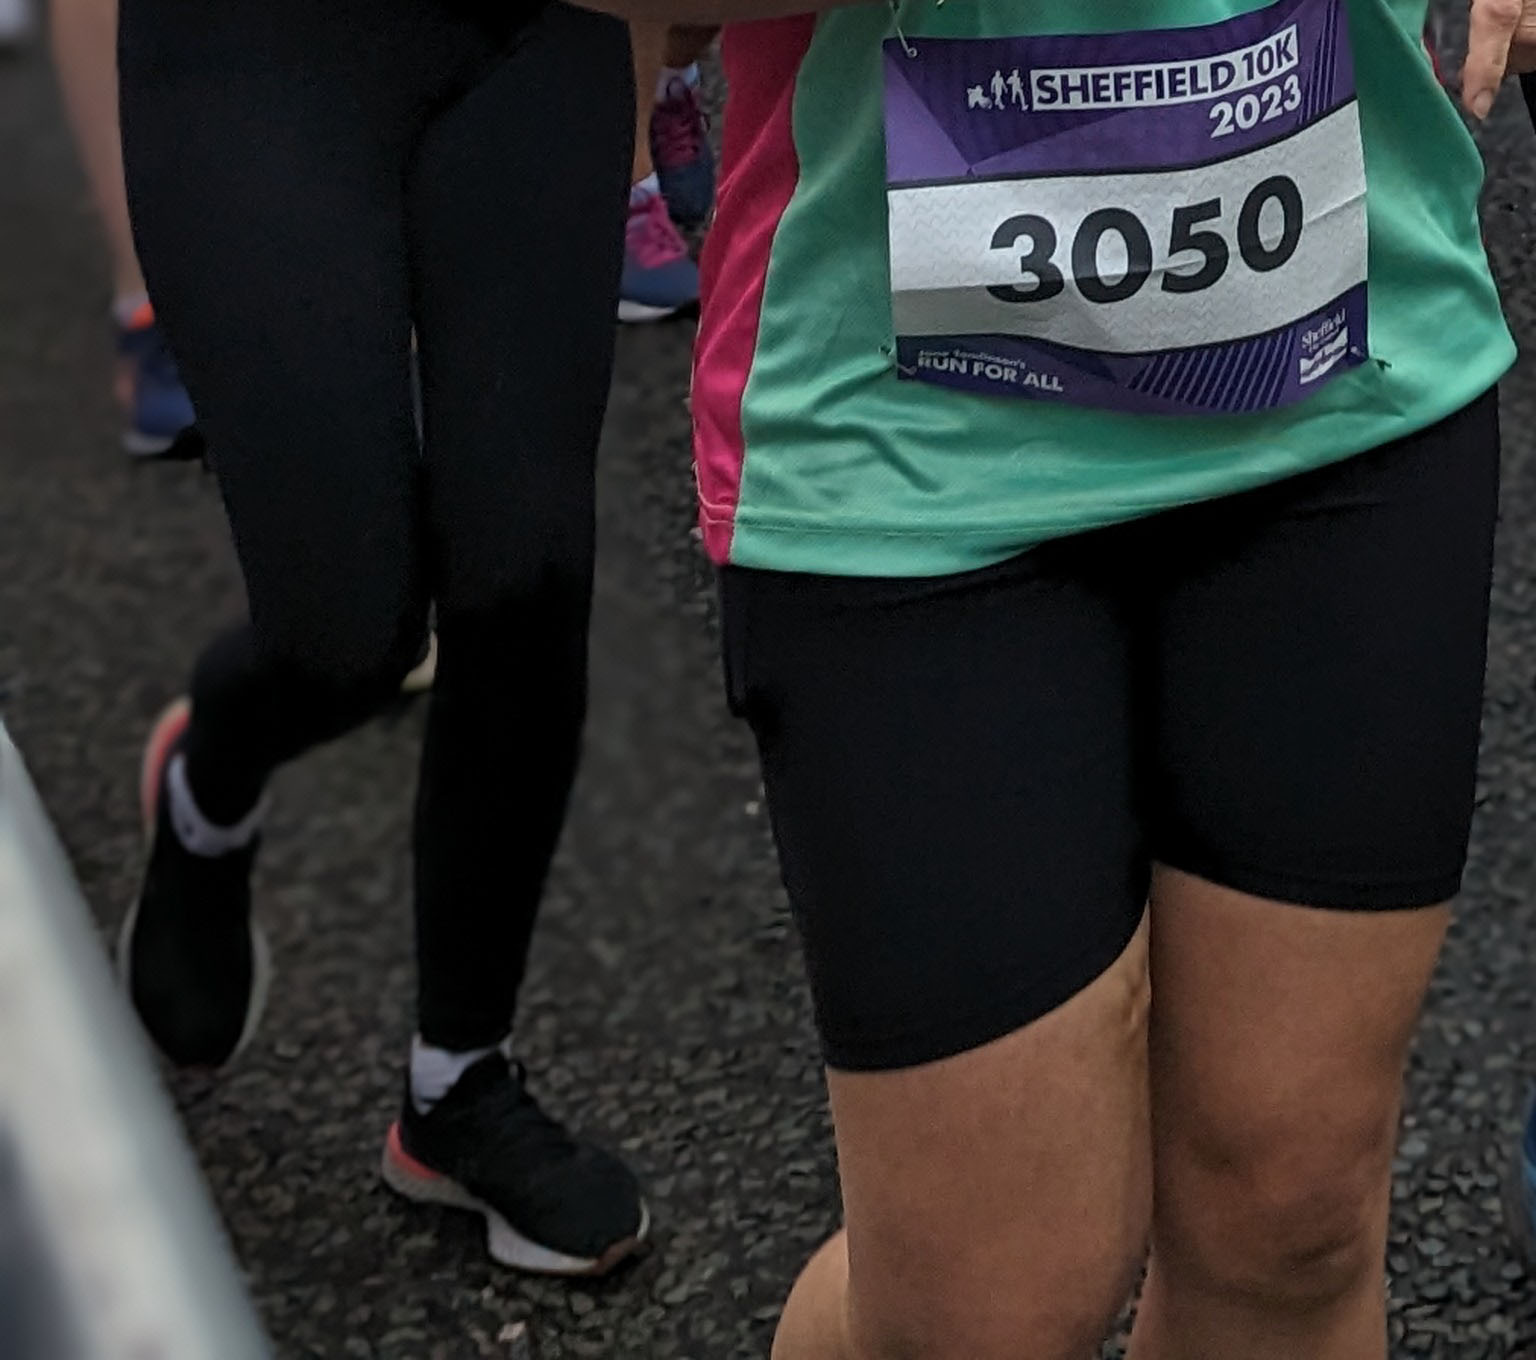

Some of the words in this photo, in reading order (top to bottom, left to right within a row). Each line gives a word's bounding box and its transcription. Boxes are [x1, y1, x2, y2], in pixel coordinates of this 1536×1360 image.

[1034, 61, 1233, 104] SHEFFIELD
[1242, 31, 1295, 80] 10K
[1210, 75, 1301, 139] 2023
[987, 175, 1303, 303] 3050
[918, 356, 967, 374] RUN
[973, 361, 1017, 383] FOR
[1024, 374, 1064, 392] ALL
